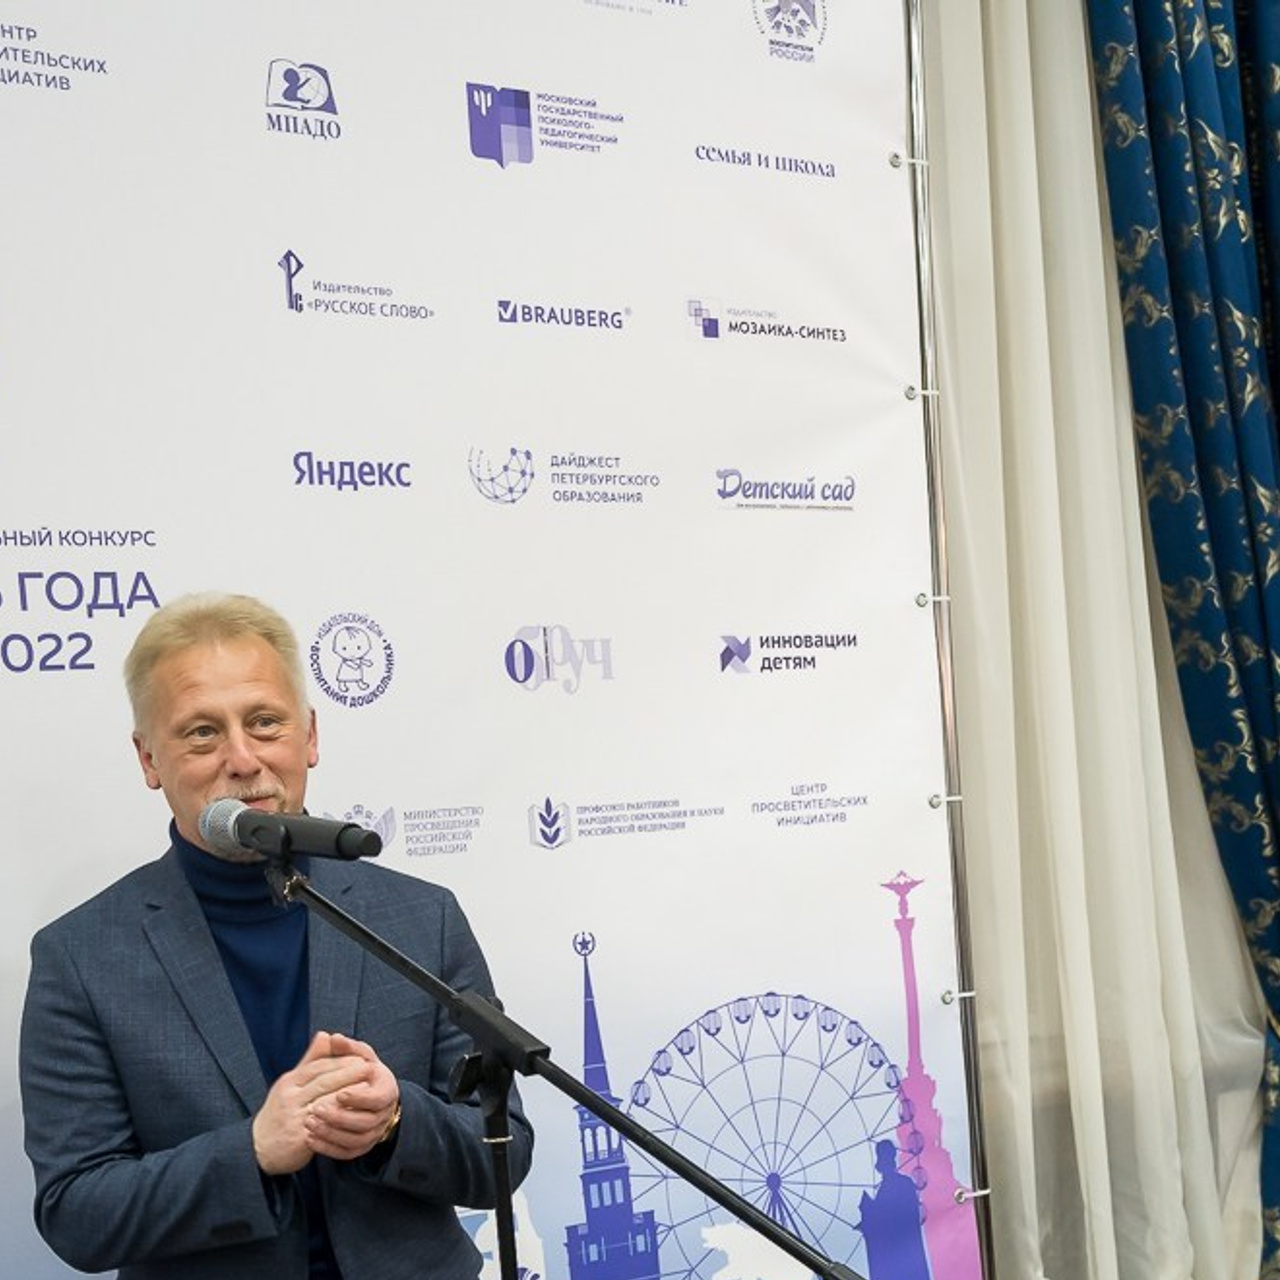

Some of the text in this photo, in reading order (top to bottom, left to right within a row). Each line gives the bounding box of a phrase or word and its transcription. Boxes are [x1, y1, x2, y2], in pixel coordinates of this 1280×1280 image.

[536, 93, 597, 108] МОСКОВСКИЙ
[537, 104, 624, 123] ГОСУДАРСТВЕННЫЙ
[266, 113, 341, 140] МПАДО
[538, 117, 595, 130] ПСИХОЛОГО-
[539, 127, 618, 144] ПЕДАГОГИЧЕСКИЙ
[539, 139, 601, 153] УНИВЕРСИТЕТ
[312, 280, 393, 297] Издательство
[307, 298, 435, 320] «РУССКОЕ СЛОВО»
[728, 321, 847, 342] МОЗАИКА-СИНТЕЗ
[550, 453, 620, 468] ДАЙДЖЕСТ
[293, 451, 412, 491] Яндекс
[551, 473, 660, 487] ПЕТЕРБУРГСКОГО
[715, 469, 855, 501] Детский сад
[552, 490, 643, 503] ОБРАЗОВАНИЯ
[0, 527, 156, 547] НЫЙ КОНКУРС
[18, 571, 160, 618] ГОДА
[759, 634, 857, 649] инновации
[759, 655, 816, 673] детям
[309, 643, 394, 708] ВОСПИТАНИЕ ДОШКОЛЬНИКА
[791, 783, 827, 796] ЦЕНТР
[403, 806, 484, 820] МИНИСТЕРСТВО
[626, 800, 680, 811] РАБОТНИКОВ
[752, 796, 868, 814] ПРОСВЕТИТЕЛЬСКИХ
[578, 814, 629, 826] НАРОДНОГО
[631, 810, 688, 821] ОБРАЗОВАНИЯ
[697, 807, 725, 816] НАУКИ
[777, 812, 847, 827] ИНИЦИАТИВ
[404, 818, 480, 833] ПРОСВЕЩЕНИЯ
[578, 821, 686, 837] РОССИЙСКОЙ ФЕДЕРАЦИИ
[405, 830, 472, 845] РОССИЙСКОЙ
[406, 844, 467, 857] ФЕДЕРАЦИИ
